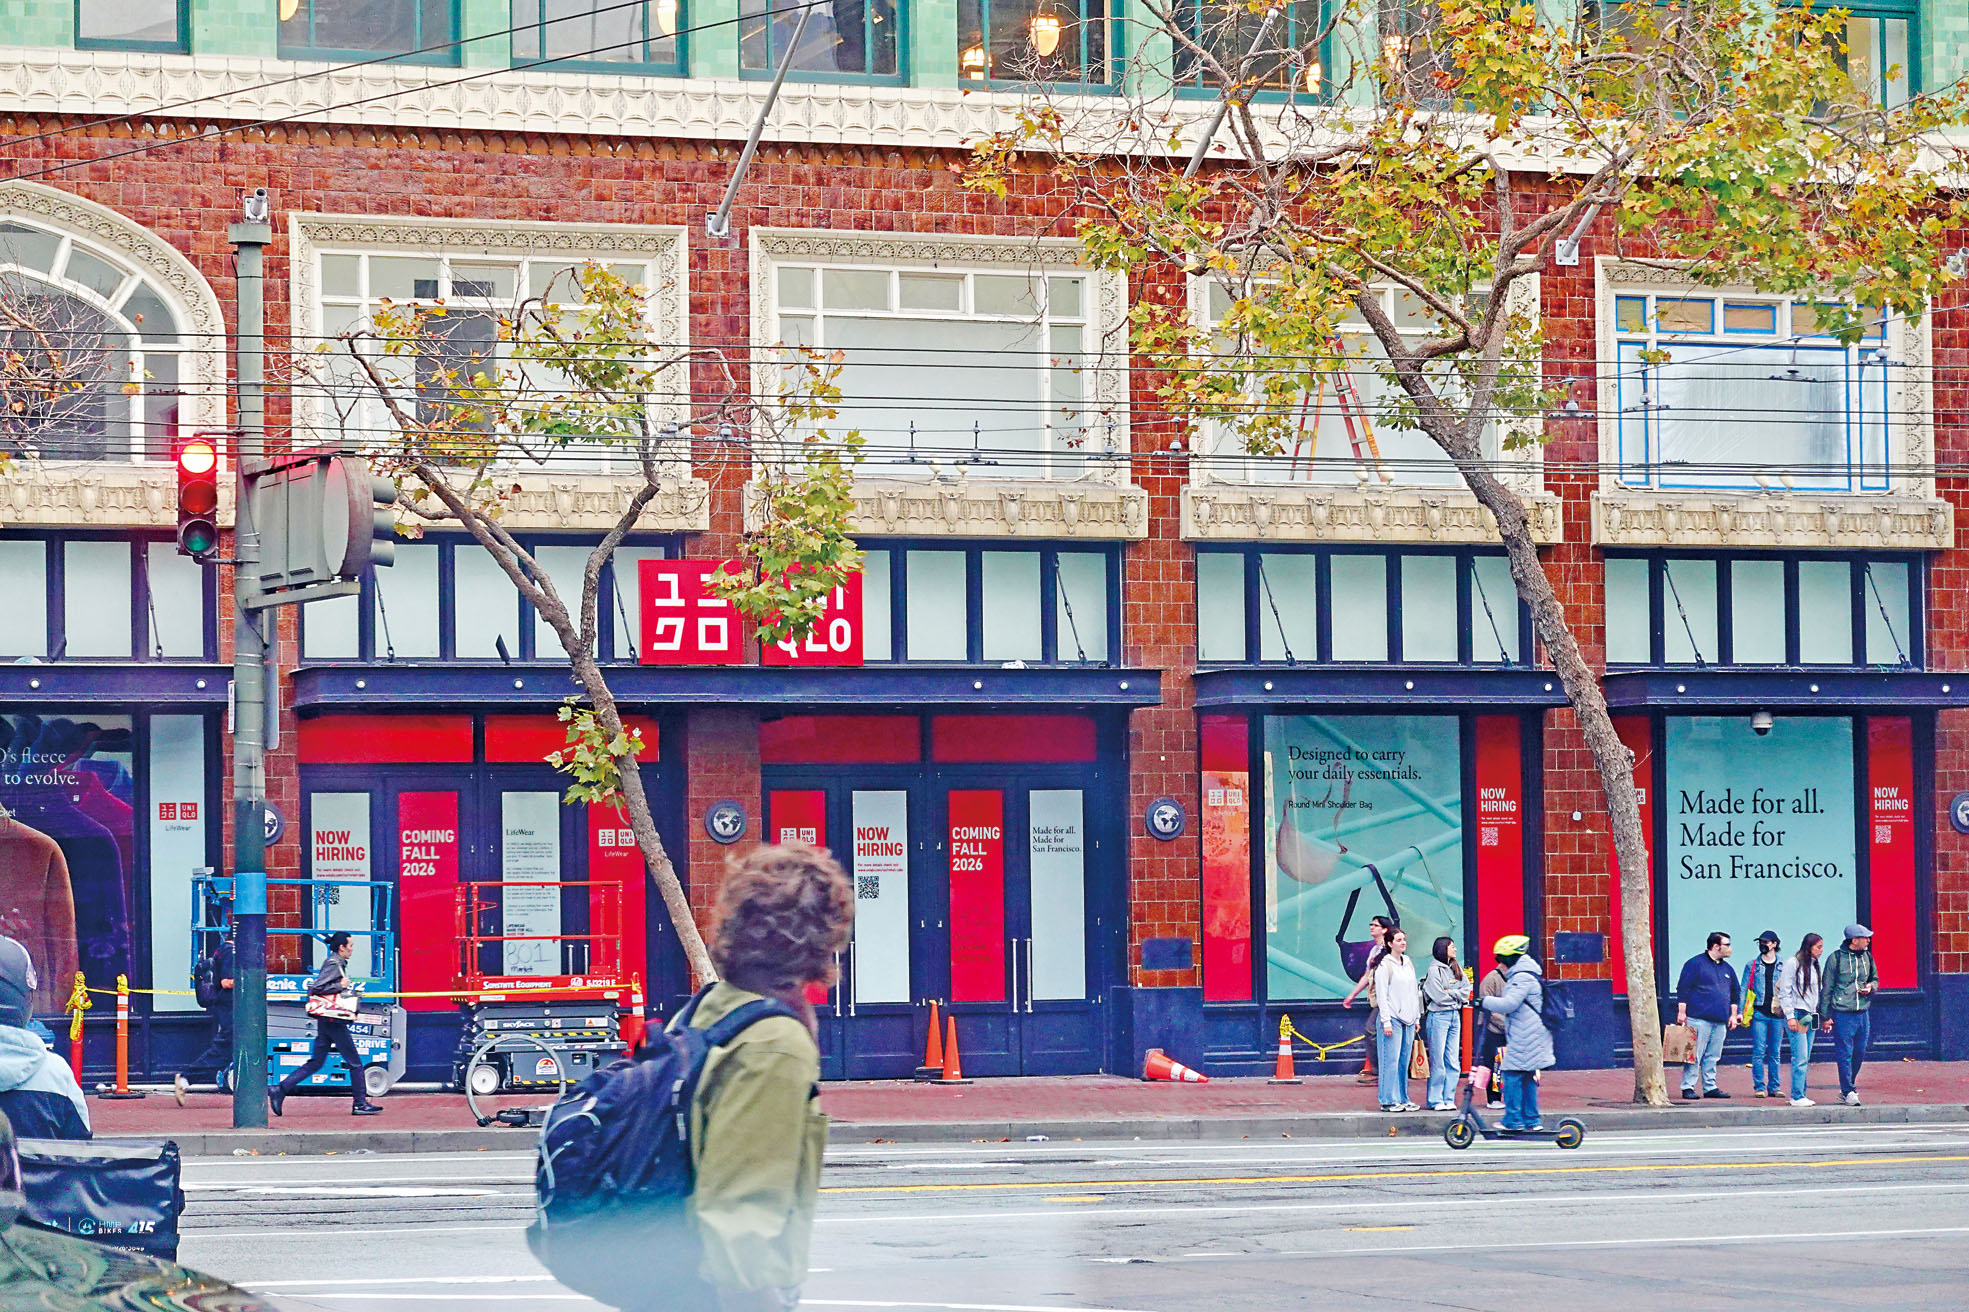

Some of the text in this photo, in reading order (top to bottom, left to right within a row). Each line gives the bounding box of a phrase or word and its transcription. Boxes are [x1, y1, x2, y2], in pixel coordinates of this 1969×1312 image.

[653, 617, 728, 650] クロ
[22, 747, 66, 763] fleece
[1288, 745, 1406, 765] Designed to carry
[5, 769, 79, 785] to evolve.
[1288, 765, 1422, 784] your daily essentials.
[1481, 788, 1506, 799] NOW
[1874, 788, 1898, 799] NOW
[1288, 801, 1373, 811] Round Mini Shoulder Bag
[1480, 800, 1517, 812] HIRING
[1679, 788, 1824, 814] Made for all.
[1874, 799, 1909, 811] HIRING
[316, 831, 350, 844] NOW
[402, 830, 454, 844] COMING
[506, 828, 535, 837] LifeWear
[857, 826, 889, 841] NOW
[952, 827, 1000, 840] COMING
[1032, 826, 1076, 835] Made for all.
[1679, 821, 1785, 847] Made for
[1032, 835, 1064, 844] Made for
[316, 846, 365, 861] HIRING
[402, 846, 440, 860] FALL
[857, 842, 903, 856] HIRING
[952, 842, 987, 856] FALL
[1032, 845, 1046, 853] San
[402, 862, 435, 876] 2026
[952, 858, 983, 871] 2026
[1679, 854, 1843, 879] San Francisco.
[506, 943, 552, 965] 801
[266, 978, 297, 990] enie
